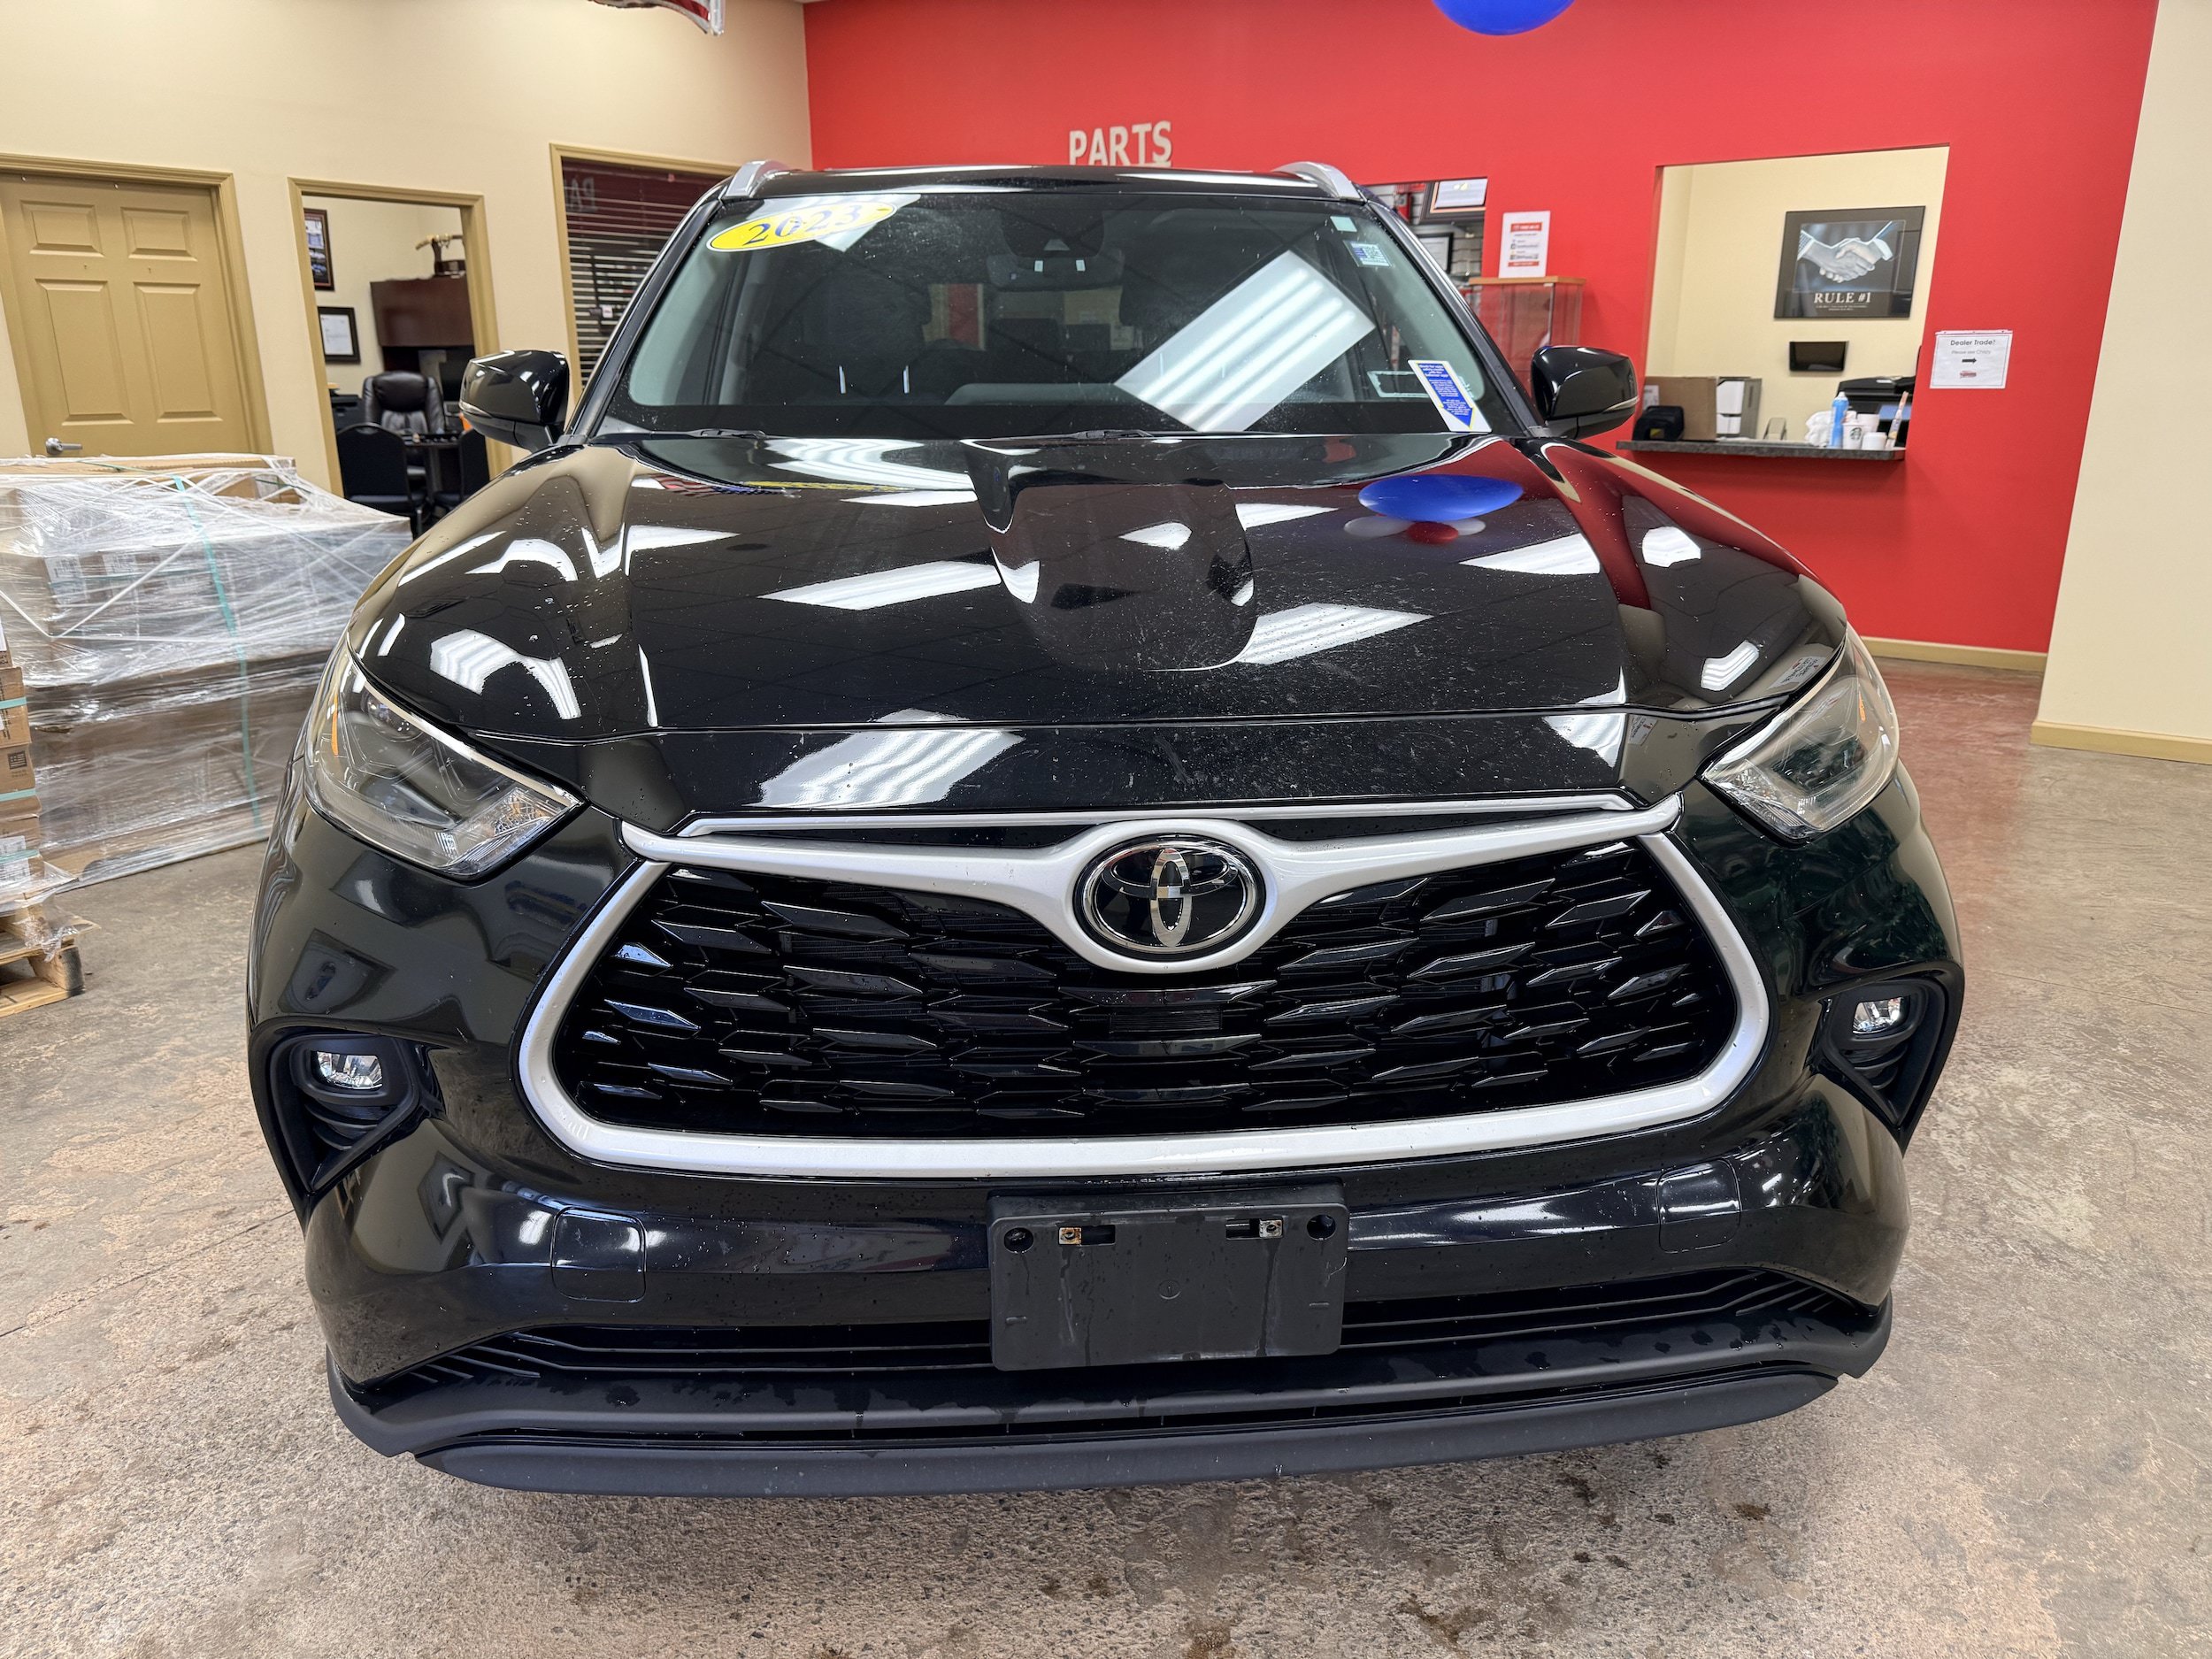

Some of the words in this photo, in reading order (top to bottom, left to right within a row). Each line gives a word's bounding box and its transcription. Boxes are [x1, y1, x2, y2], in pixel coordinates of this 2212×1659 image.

[1069, 120, 1172, 167] PARTS
[742, 204, 863, 246] 2023
[1814, 292, 1855, 303] RULE
[1858, 292, 1871, 303] #1
